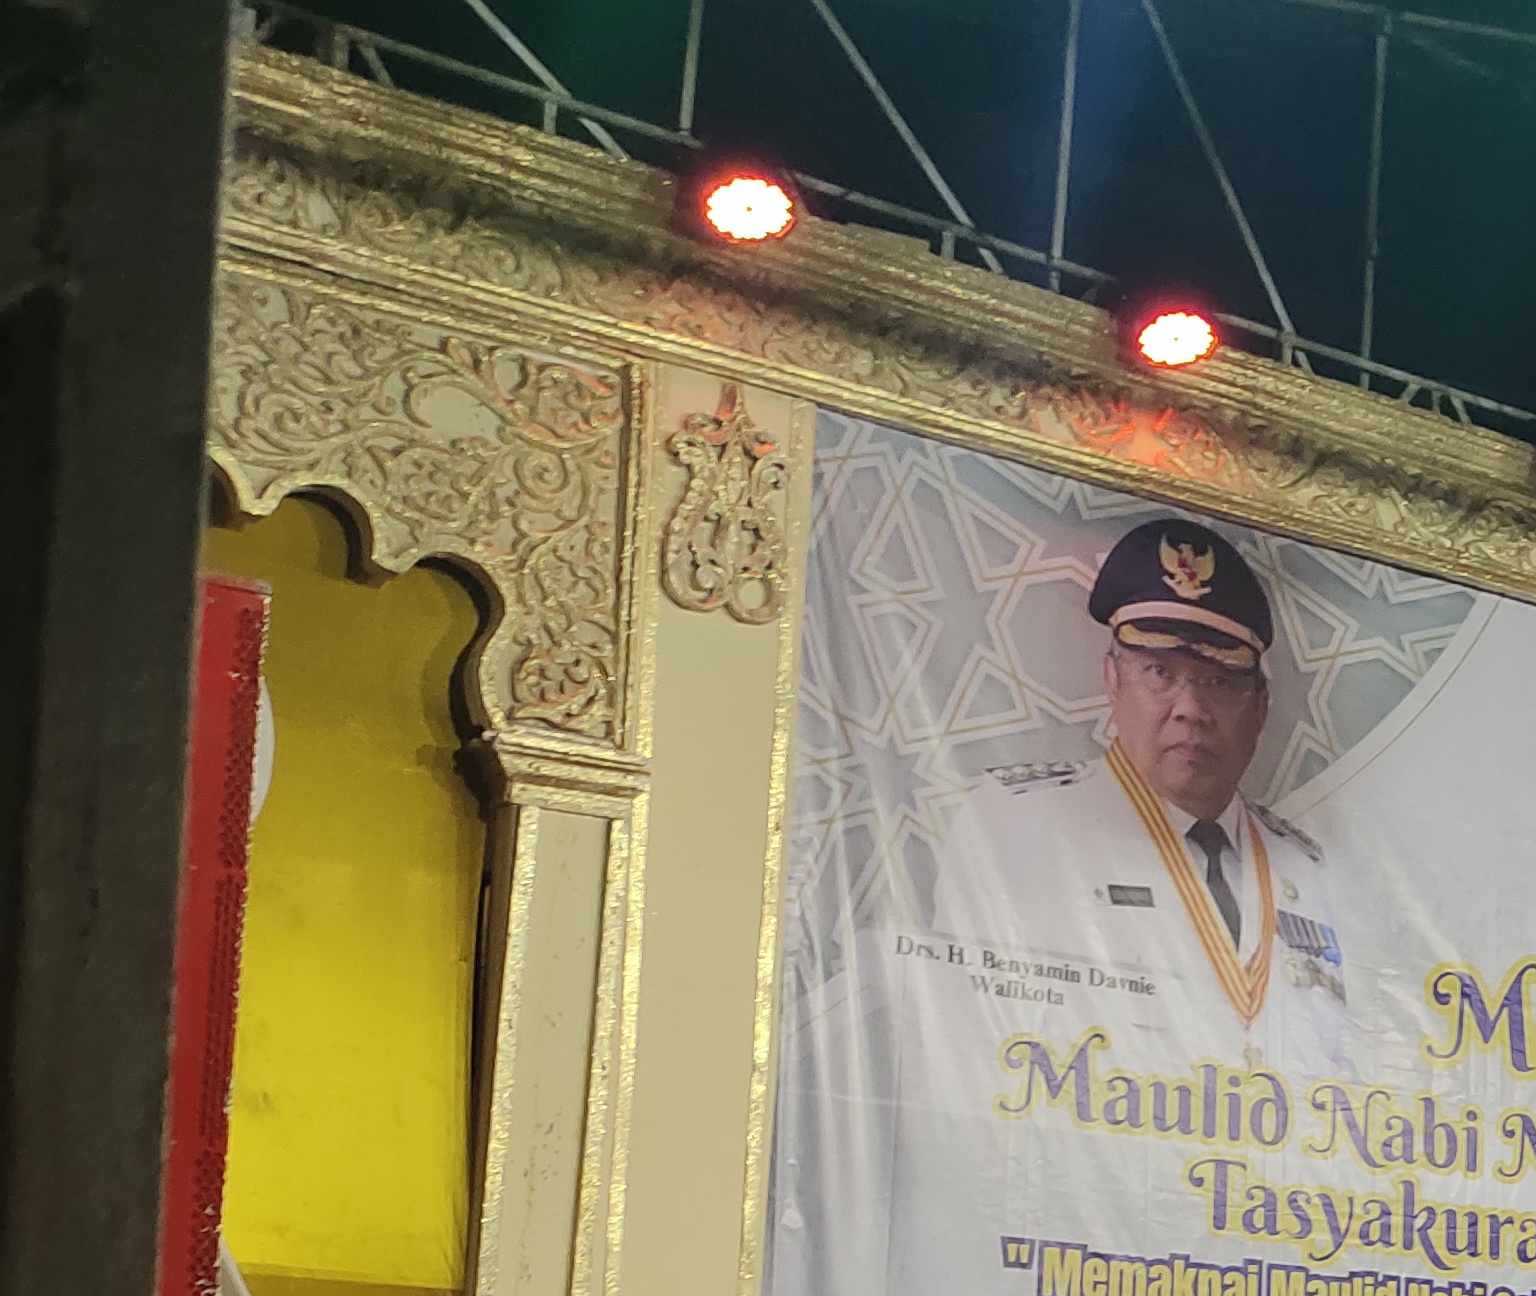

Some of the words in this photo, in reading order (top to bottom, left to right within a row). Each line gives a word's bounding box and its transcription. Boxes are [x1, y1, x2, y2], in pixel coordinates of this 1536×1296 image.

[946, 943, 973, 966] H.
[982, 949, 1081, 983] Benyamin
[1087, 967, 1157, 996] Davnie
[969, 974, 1065, 1006] Walikota
[998, 1032, 1290, 1147] Maulid
[1307, 1084, 1480, 1174] Nabi
